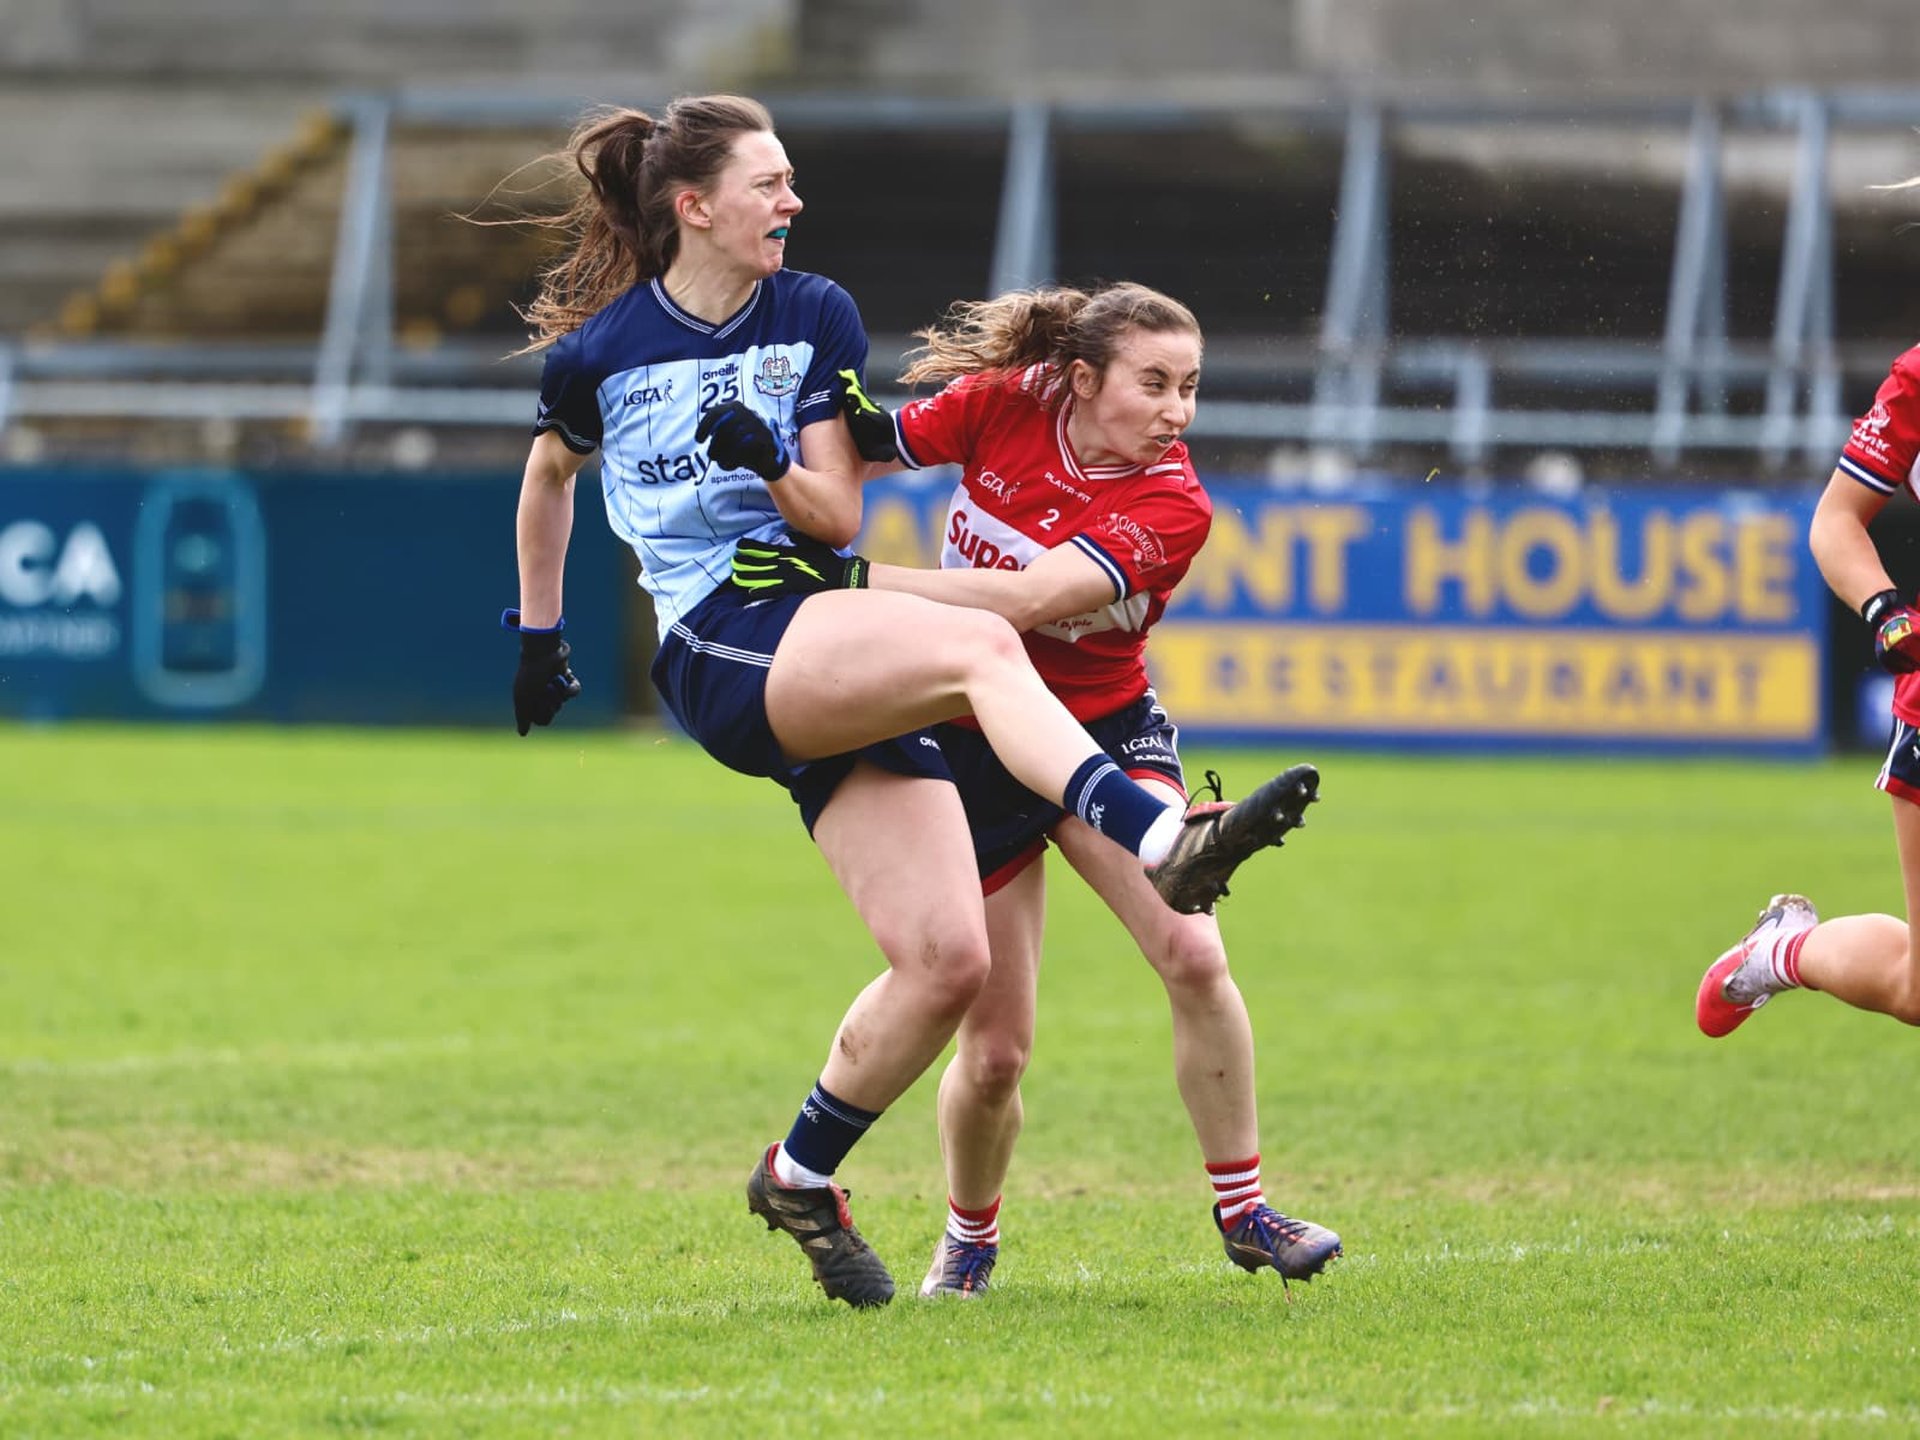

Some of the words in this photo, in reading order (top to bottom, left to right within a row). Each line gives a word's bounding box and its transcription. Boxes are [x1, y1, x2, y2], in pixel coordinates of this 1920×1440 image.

[623, 387, 662, 407] LGFA
[701, 375, 738, 413] 25
[637, 451, 711, 486] stay
[1038, 508, 1060, 532] 2
[1406, 504, 1796, 620] HOUSE
[1202, 645, 1768, 712] RESTAURANT
